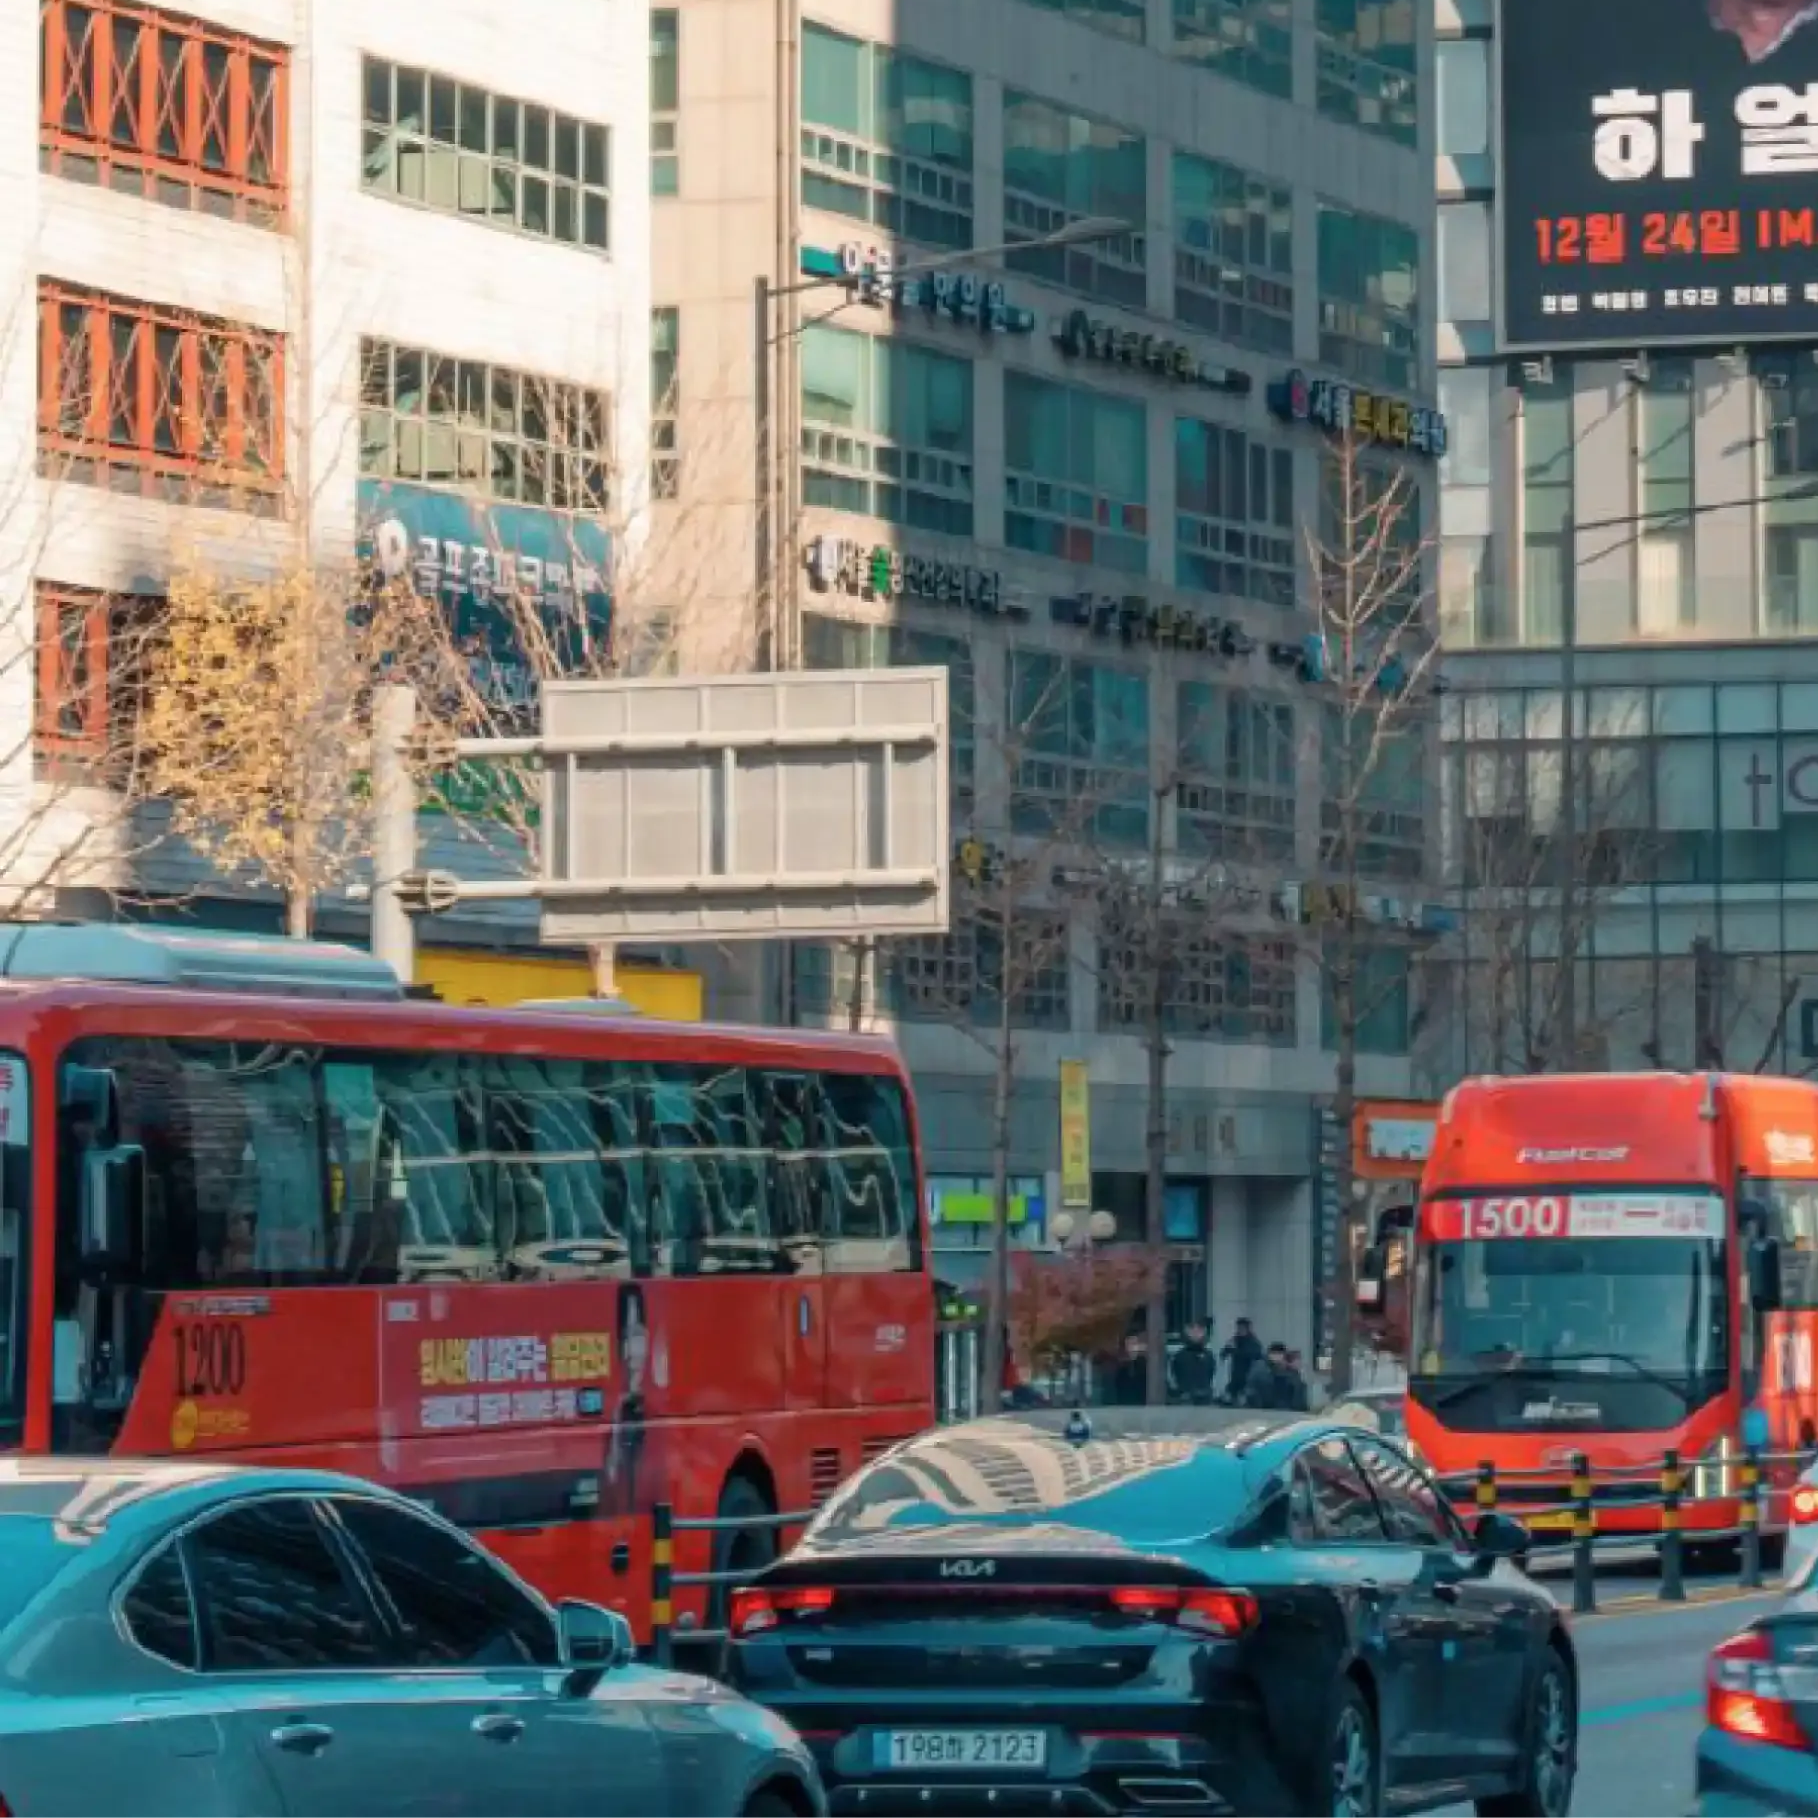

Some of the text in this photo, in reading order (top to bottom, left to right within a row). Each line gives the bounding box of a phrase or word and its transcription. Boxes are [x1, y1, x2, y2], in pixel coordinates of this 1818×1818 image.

[1535, 212, 1626, 265] 12월
[1642, 208, 1740, 255] 24일
[1462, 1196, 1561, 1239] 1500
[972, 1734, 1038, 1762] 2123
